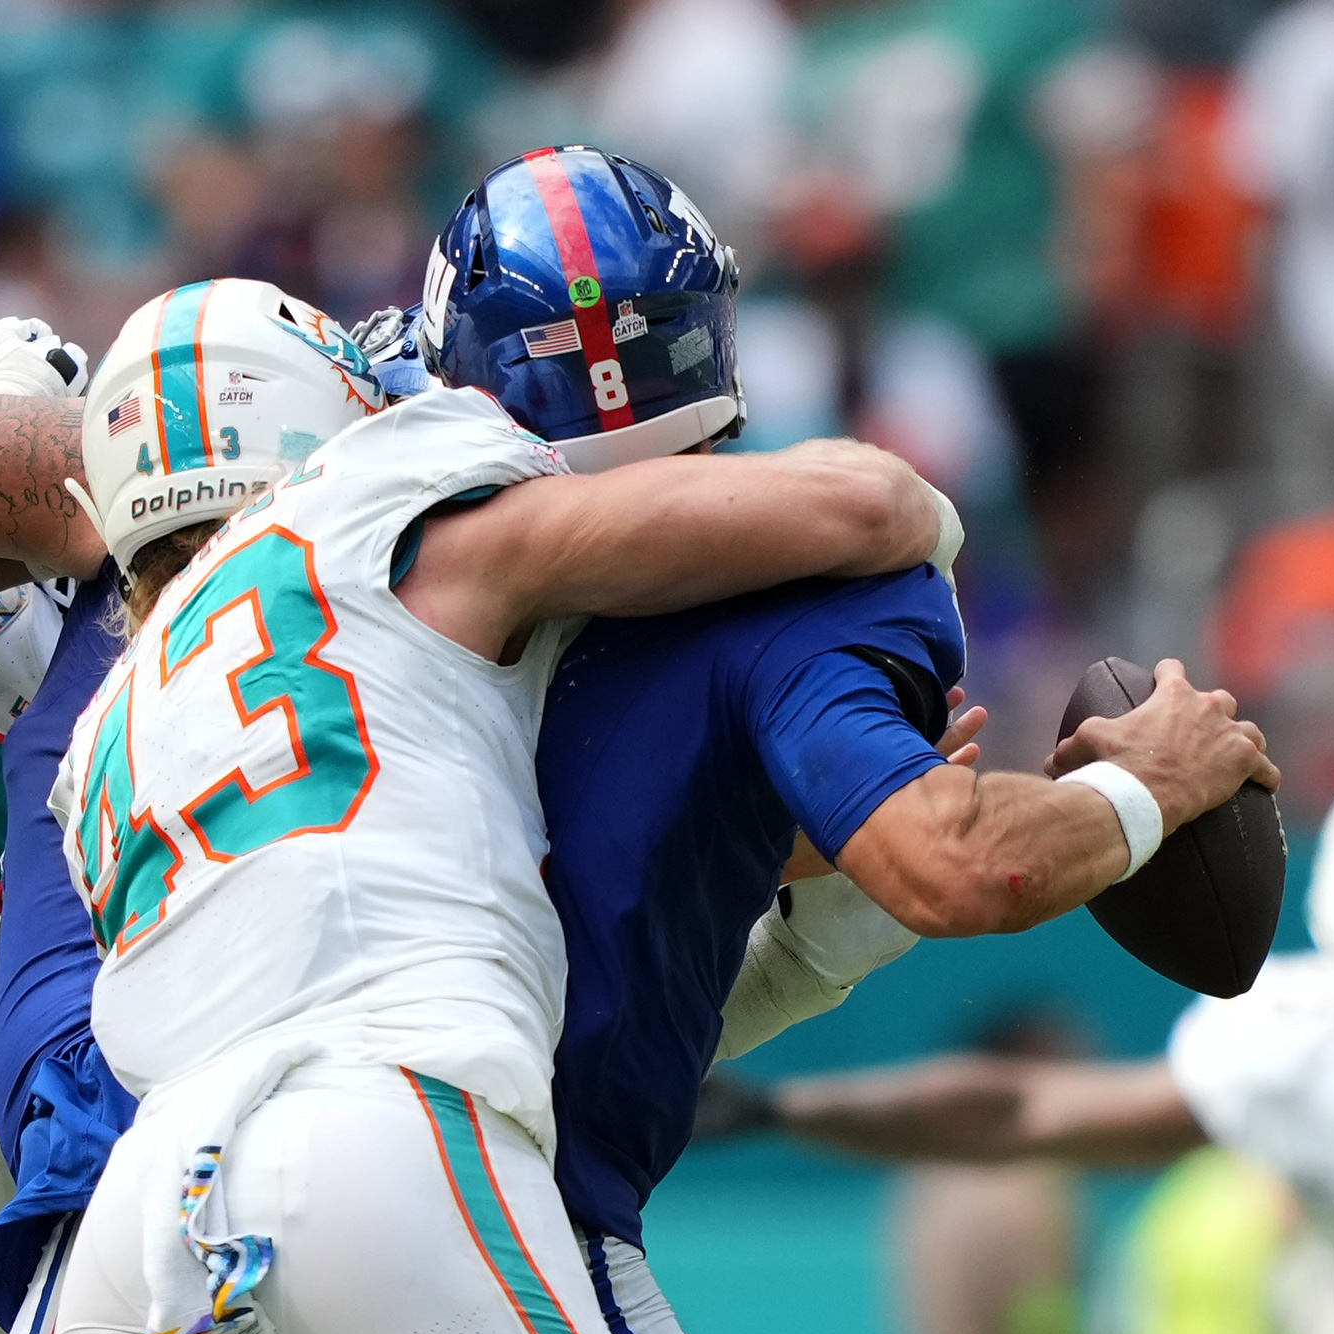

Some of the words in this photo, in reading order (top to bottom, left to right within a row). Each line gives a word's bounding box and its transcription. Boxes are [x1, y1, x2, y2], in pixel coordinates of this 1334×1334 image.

[614, 318, 645, 337] CATCH
[219, 391, 253, 402] CATCH
[589, 358, 629, 411] 8
[136, 442, 154, 476] 4
[220, 426, 241, 460] 3
[131, 477, 268, 519] Dolphins
[76, 523, 381, 958] 43
